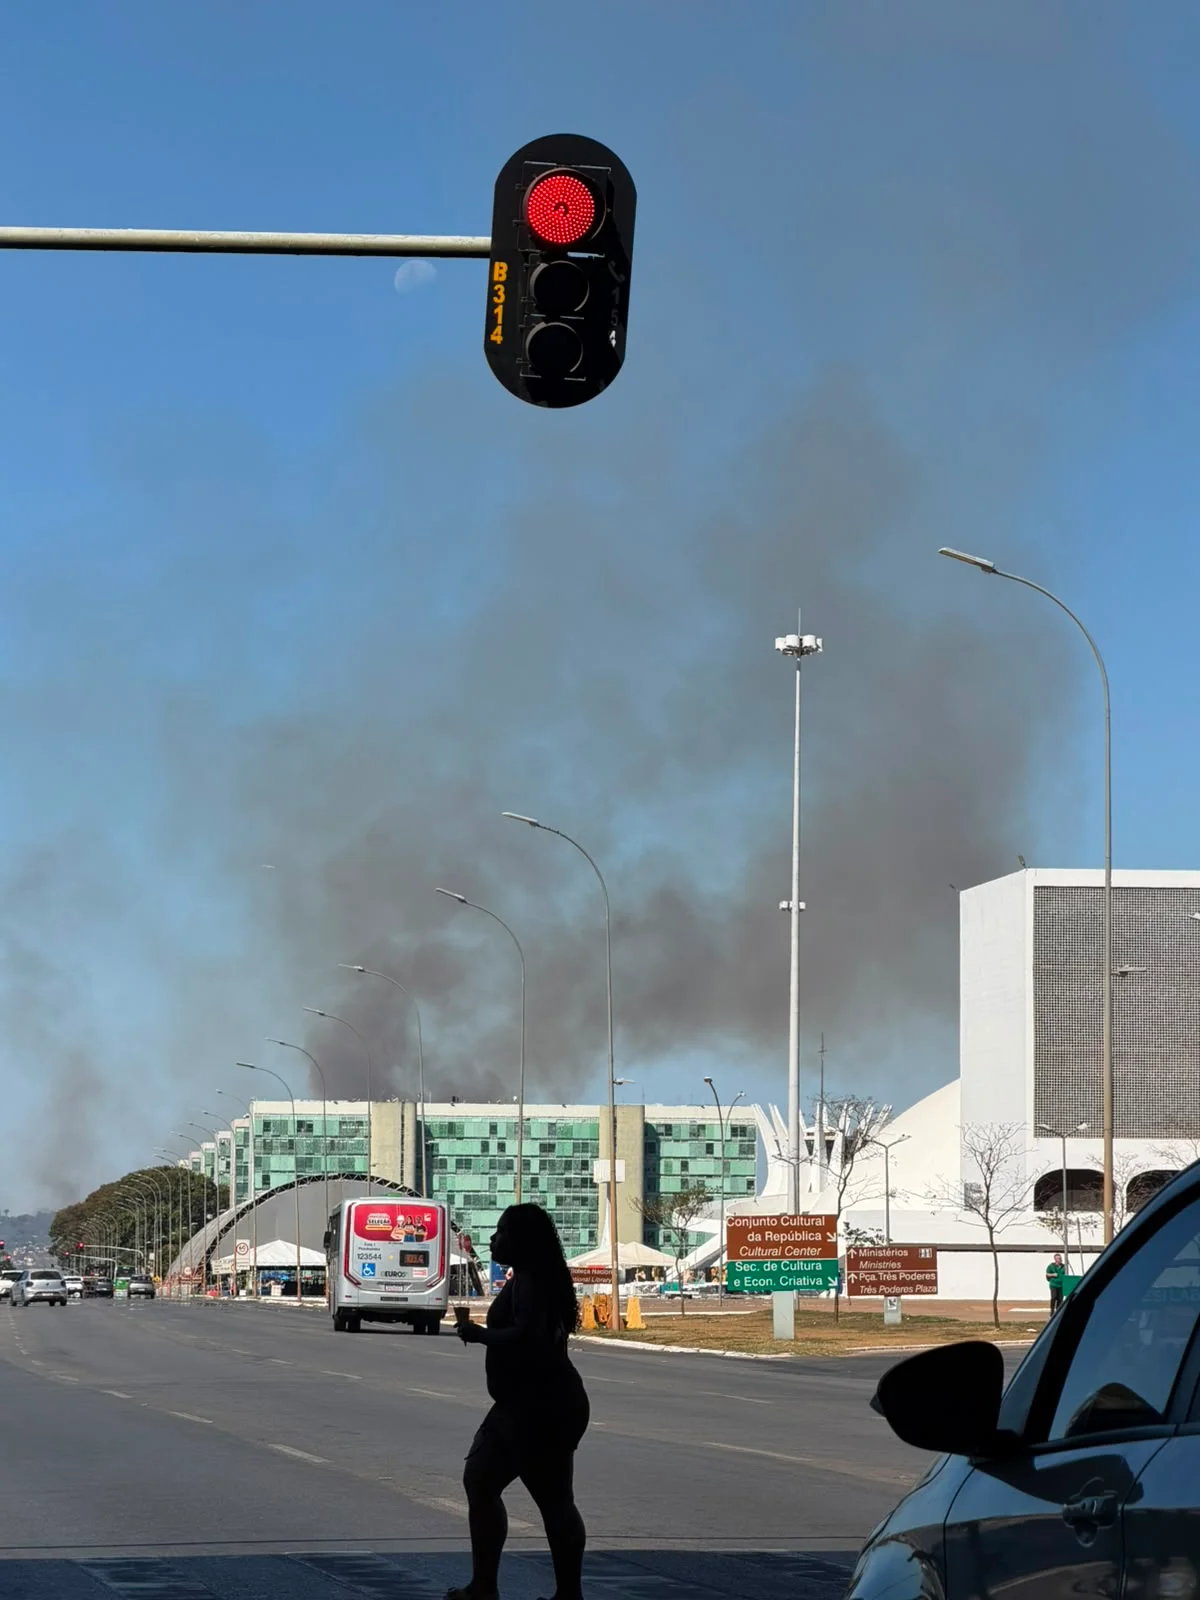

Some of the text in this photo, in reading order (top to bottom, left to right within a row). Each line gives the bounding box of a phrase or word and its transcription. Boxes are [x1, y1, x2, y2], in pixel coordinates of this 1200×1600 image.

[726, 1216, 825, 1228] Conjunto Cultural
[747, 1231, 822, 1243] da República
[739, 1246, 822, 1257] Cultural Center
[859, 1248, 909, 1257] Ministérios
[735, 1260, 822, 1271] Sec. de Cultura
[859, 1261, 902, 1269] Ministries
[734, 1276, 823, 1287] e Econ. Criativa
[879, 1272, 897, 1281] Três
[899, 1272, 936, 1281] Poderes
[860, 1284, 937, 1294] Três Poderes Plaza
